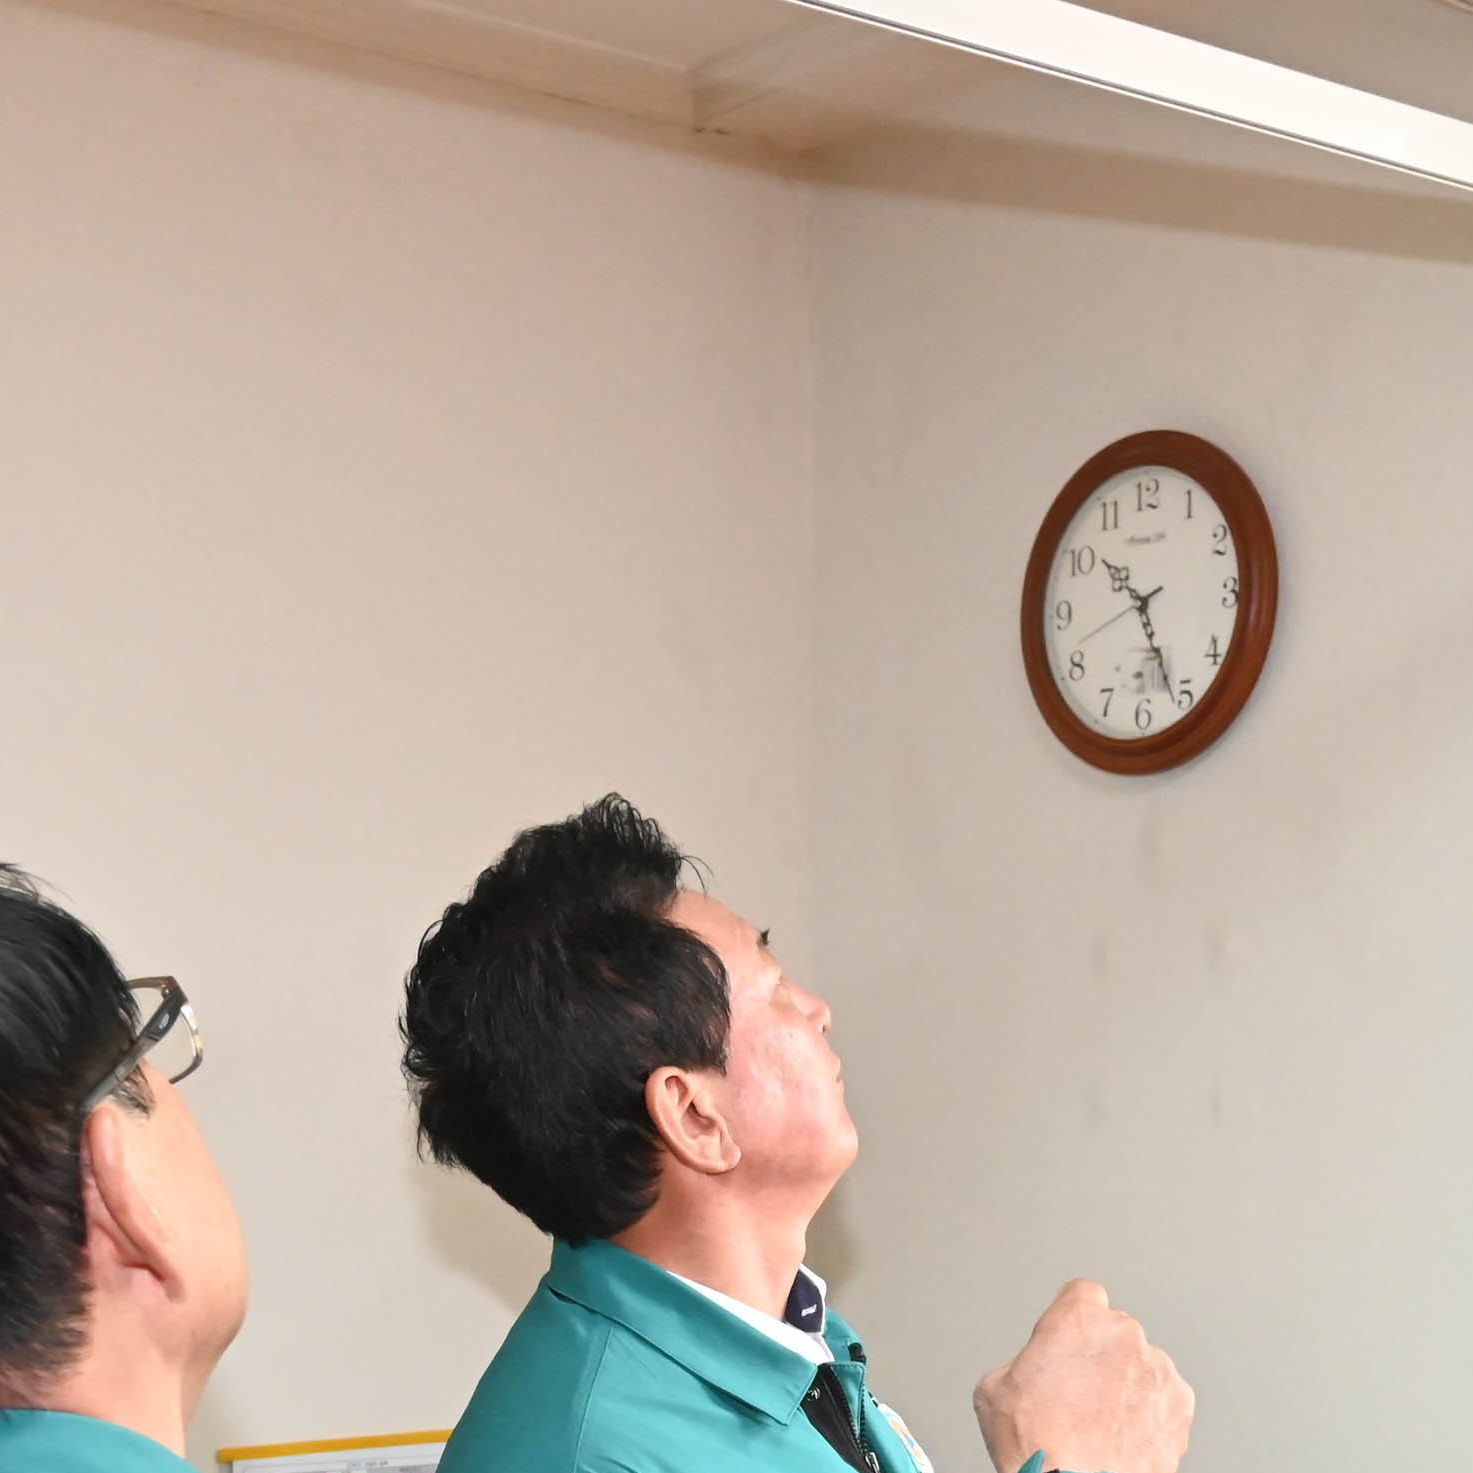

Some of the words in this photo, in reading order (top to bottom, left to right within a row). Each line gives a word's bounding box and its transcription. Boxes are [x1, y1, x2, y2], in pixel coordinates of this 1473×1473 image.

[1135, 478, 1161, 512] 12
[1185, 488, 1196, 521] 1
[1100, 500, 1120, 532] 11
[1212, 524, 1229, 557] 2
[1069, 546, 1096, 578] 10
[1223, 576, 1240, 609] 3
[1055, 600, 1073, 632] 9
[1069, 650, 1086, 682] 8
[1204, 634, 1222, 666] 4
[1100, 687, 1116, 718] 7
[1178, 679, 1194, 709] 5
[1134, 698, 1152, 731] 6
